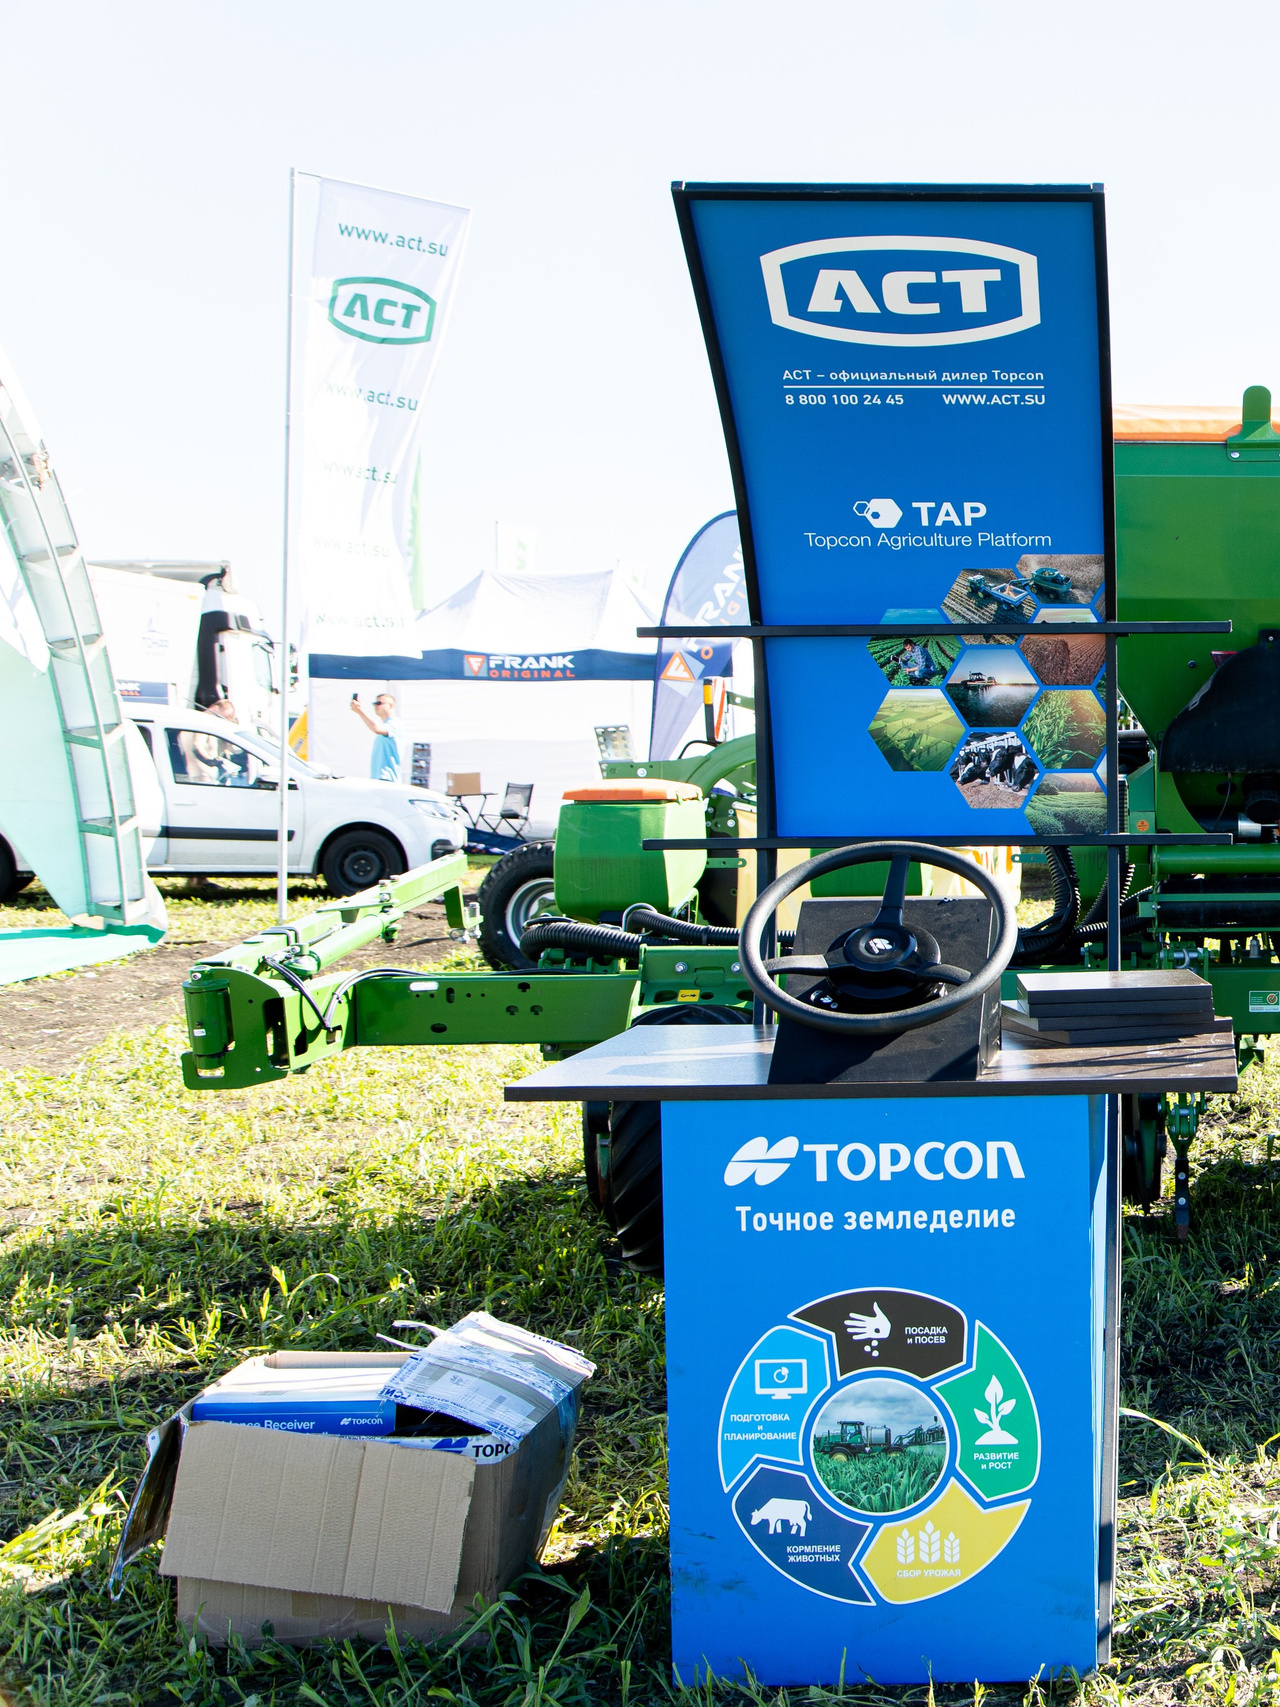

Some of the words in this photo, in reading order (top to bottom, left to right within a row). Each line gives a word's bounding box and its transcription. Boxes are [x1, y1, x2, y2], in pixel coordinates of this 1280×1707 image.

[337, 222, 449, 257] www.act.su
[806, 268, 1002, 315] ACT
[342, 293, 421, 329] ACT
[829, 369, 937, 383] официальный
[941, 372, 988, 383] дилер
[991, 369, 1044, 383] Topcon
[785, 394, 795, 405] 8
[798, 394, 827, 405] 800
[832, 394, 859, 405] 100
[863, 394, 882, 405] 24
[885, 394, 904, 405] 45
[942, 393, 1046, 405] WWW.ACT.SU
[911, 501, 987, 527] TAP
[803, 532, 871, 550] Topcon
[877, 532, 972, 551] Agriculture
[978, 532, 1052, 547] Platform
[488, 655, 576, 669] FRANK
[489, 669, 576, 679] ORIGINAL
[803, 1140, 1026, 1182] TOPCON
[735, 1205, 834, 1232] Точное
[843, 1208, 1016, 1234] земледелие
[904, 1326, 949, 1336] ПОСАДКА
[906, 1337, 913, 1345] и
[914, 1335, 946, 1344] ПОСЕВ
[352, 1417, 384, 1426] TOPCON
[729, 1413, 790, 1423] ПОДГОТОВКА
[263, 1419, 316, 1431] Receiver
[723, 1432, 797, 1441] ПЛАНИРОВАНИЕ
[973, 1452, 1020, 1461] РАЗВИТИЕ
[988, 1461, 1013, 1470] РОСТ
[786, 1544, 842, 1554] КОРМЛЕНИЕ
[787, 1554, 841, 1563] ЖИВОТНЫХ
[896, 1569, 922, 1578] СБОР
[923, 1568, 962, 1577] УРОЖАЯ
